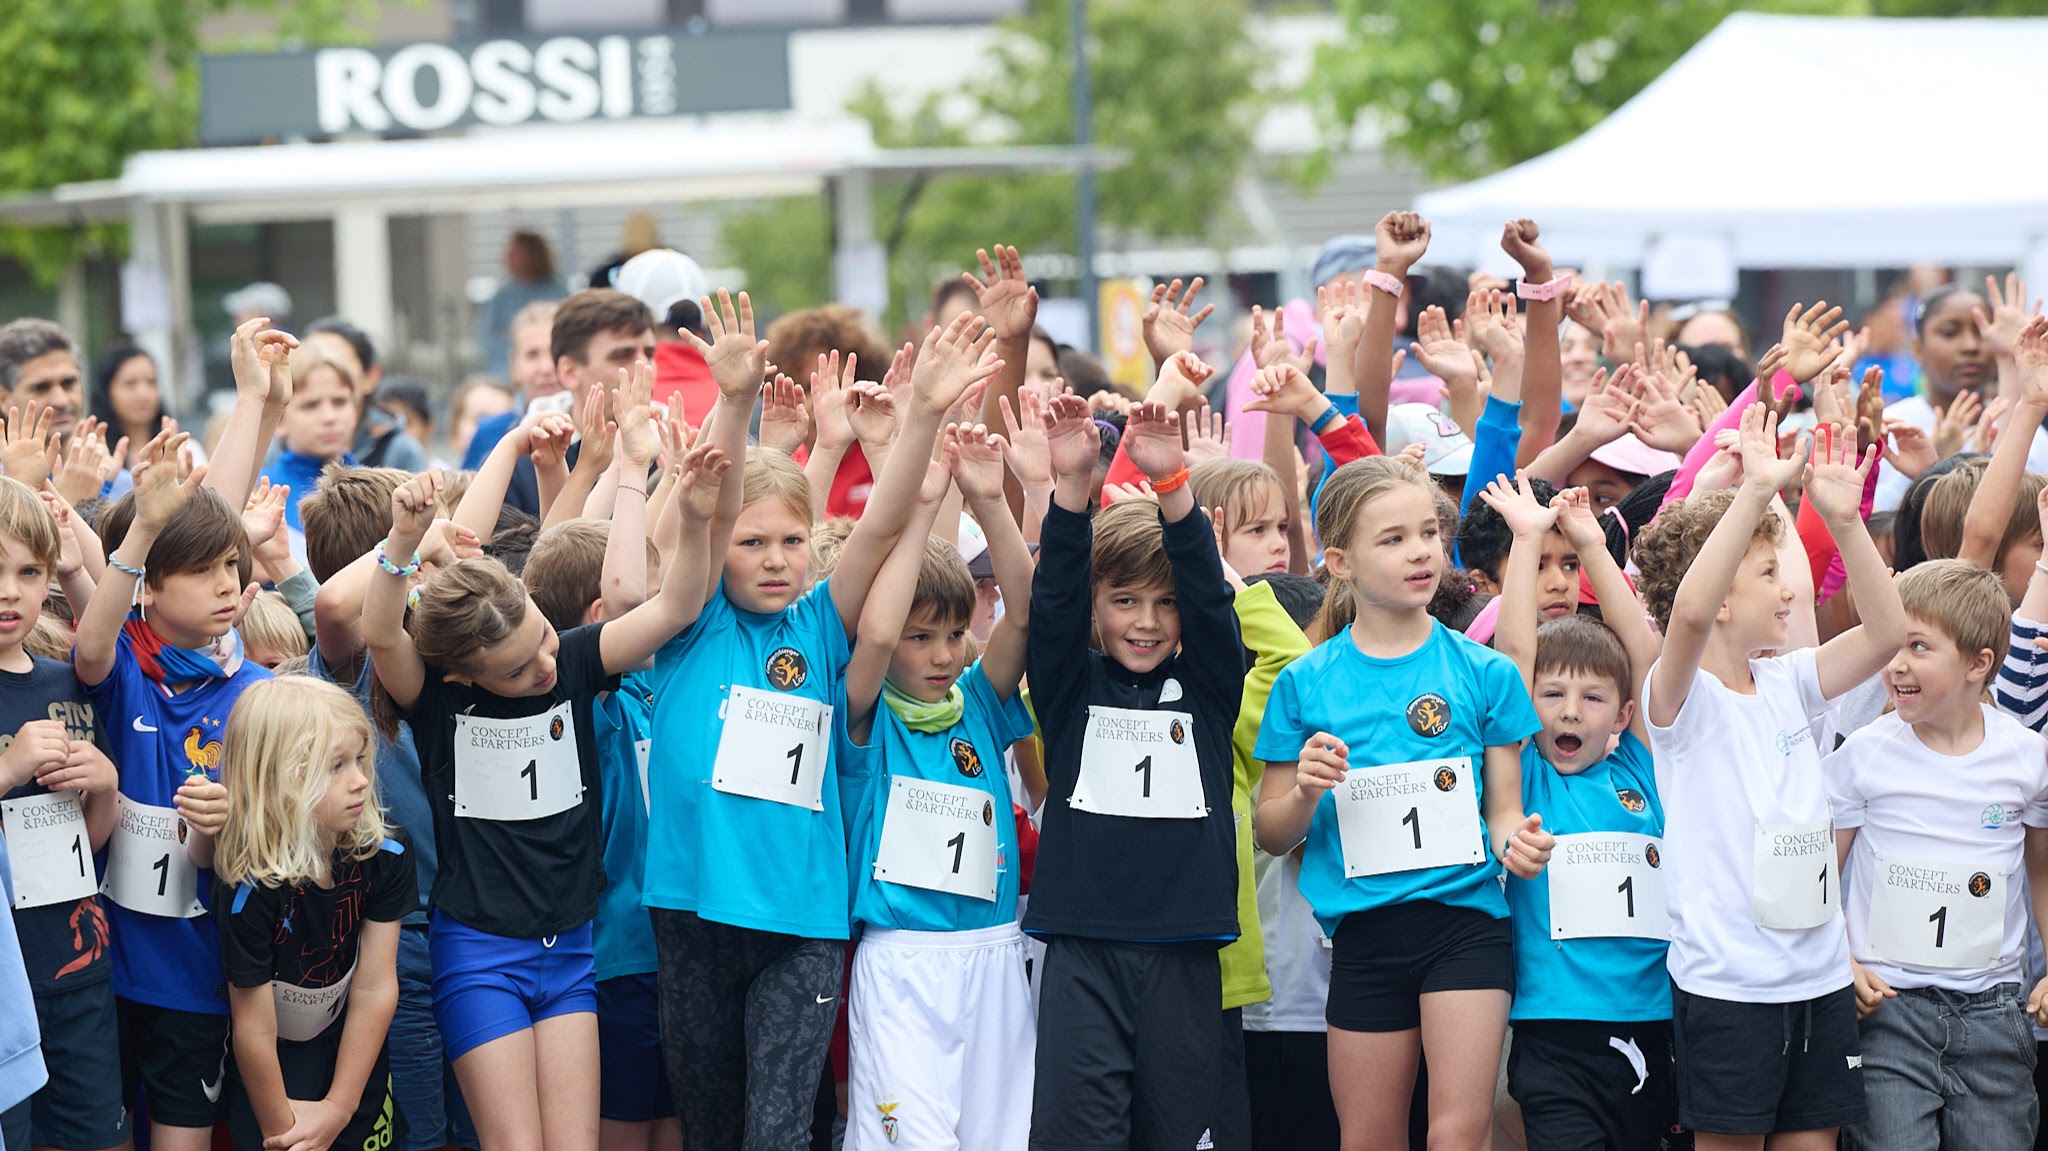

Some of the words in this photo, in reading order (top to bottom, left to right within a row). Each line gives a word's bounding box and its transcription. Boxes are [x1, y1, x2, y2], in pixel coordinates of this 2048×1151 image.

[315, 35, 634, 133] ROSSI
[47, 700, 94, 728] CITY
[746, 698, 808, 719] CONCEPT
[744, 709, 816, 732] &PARTNERS
[1097, 717, 1150, 731] CONCEPT
[471, 726, 532, 739] CONCEPT
[471, 735, 546, 750] &PARTNERS
[1095, 728, 1164, 743] &PARTNERS
[787, 743, 804, 785] 1
[521, 759, 538, 801] 1
[1135, 755, 1152, 798] 1
[1349, 772, 1411, 790] CONCEPT
[908, 787, 969, 807] CONCEPT
[1351, 782, 1427, 802] &PARTNERS
[22, 799, 74, 818] CONCEPT
[122, 807, 171, 828] CONCEPT
[905, 799, 979, 821] &PARTNERS
[120, 817, 177, 841] &PARTNERS
[1402, 806, 1421, 849] 1
[1774, 829, 1828, 846] CONCEPT
[72, 834, 85, 877] 1
[947, 832, 965, 874] 1
[1566, 841, 1628, 854] CONCEPT
[1566, 853, 1641, 865] &PARTNERS
[153, 853, 170, 896] 1
[1889, 864, 1948, 882] CONCEPT
[1818, 863, 1828, 905] 1
[1887, 875, 1961, 895] &PARTNERS
[1618, 876, 1635, 918] 1
[1929, 906, 1947, 948] 1
